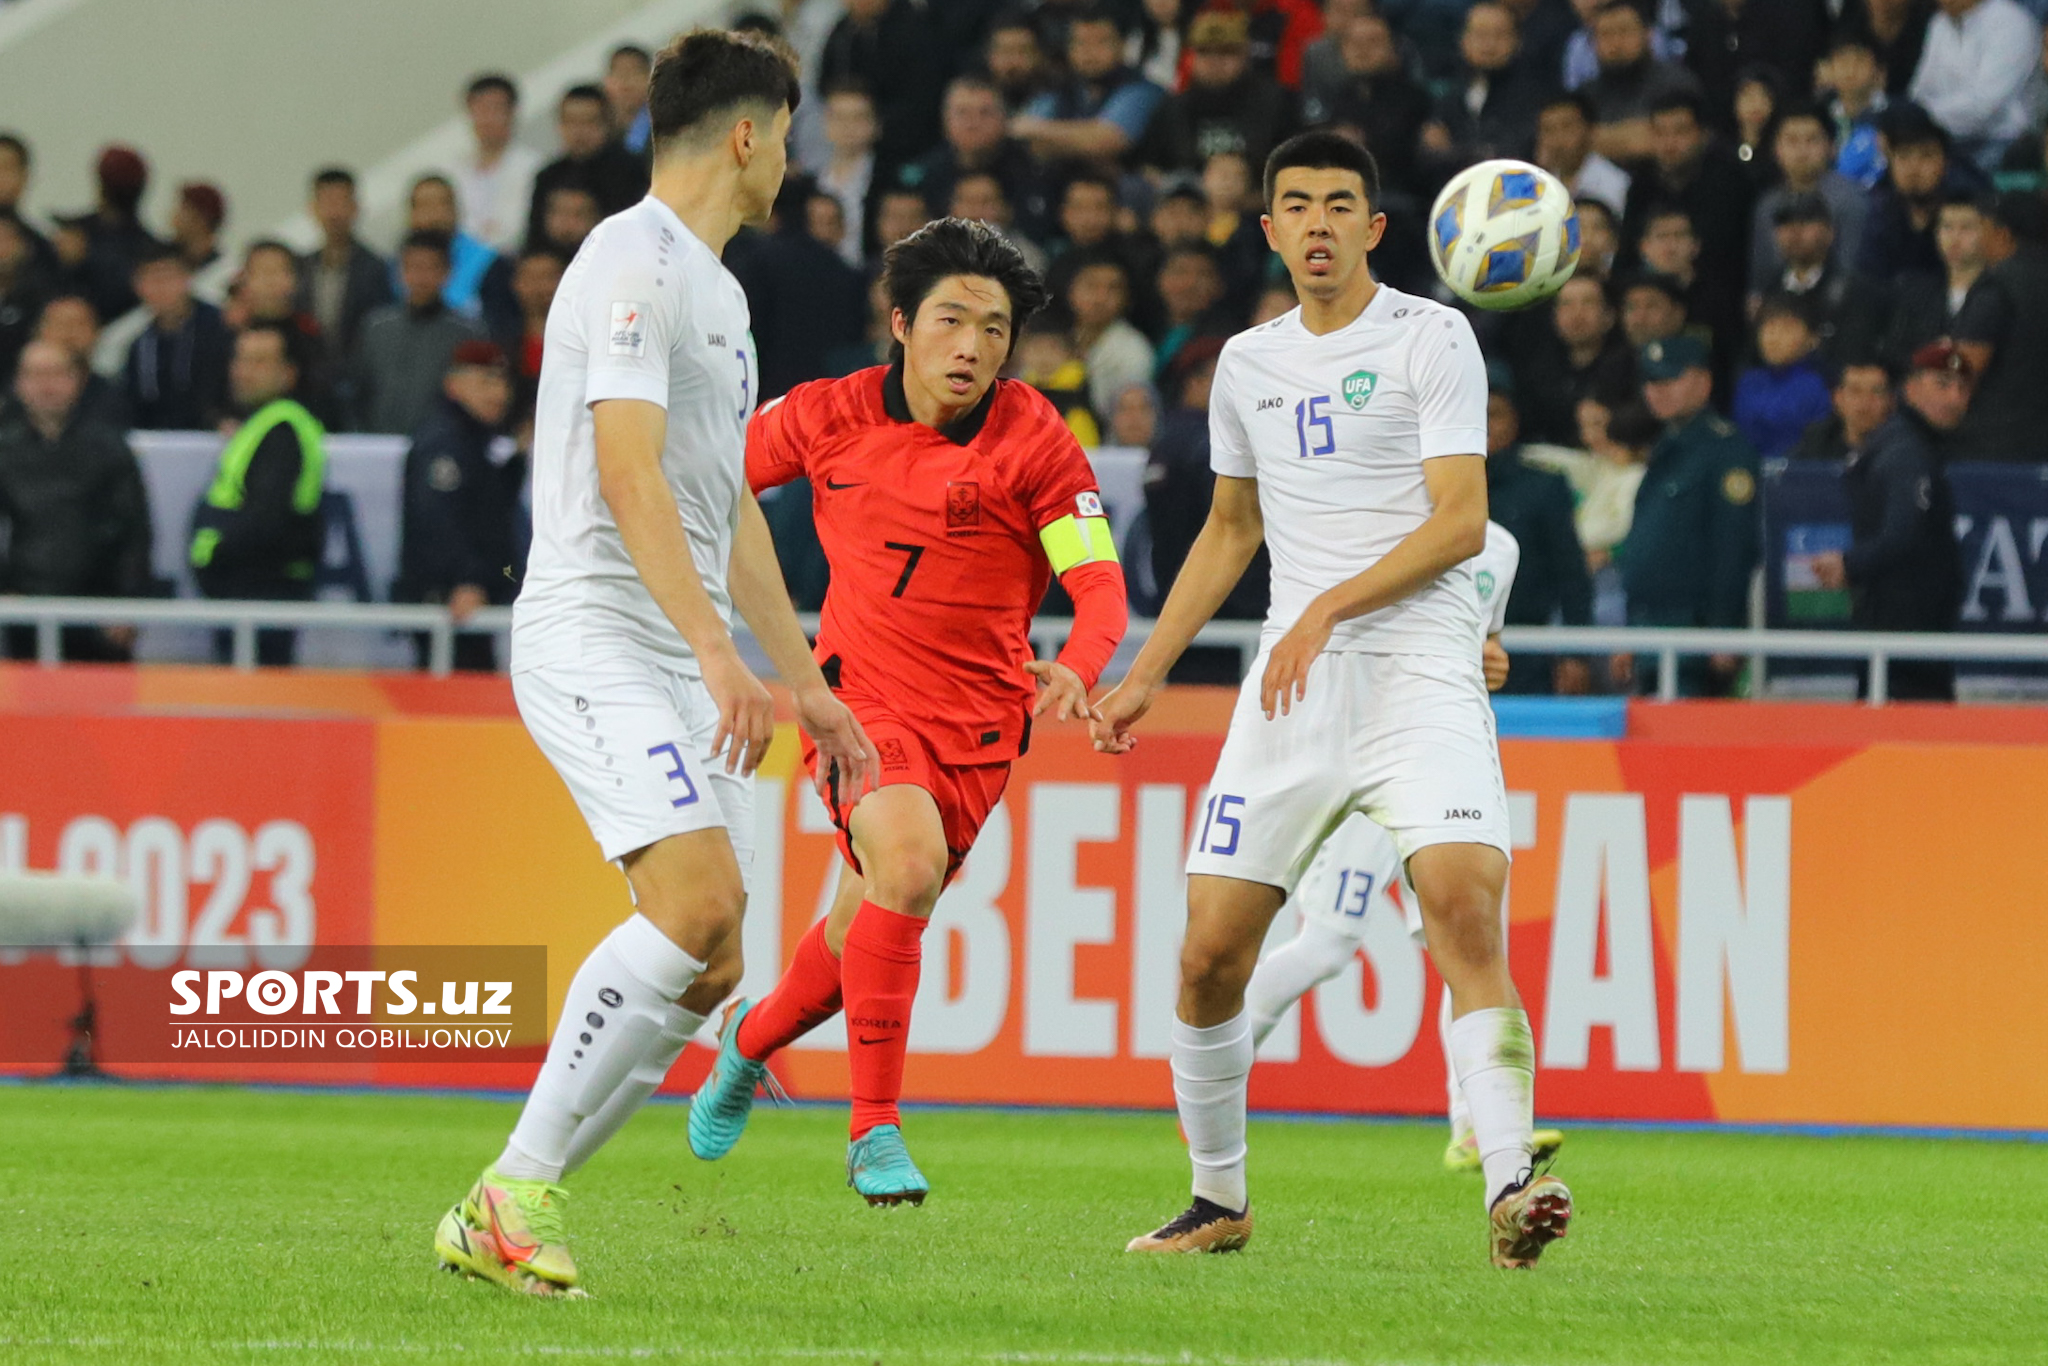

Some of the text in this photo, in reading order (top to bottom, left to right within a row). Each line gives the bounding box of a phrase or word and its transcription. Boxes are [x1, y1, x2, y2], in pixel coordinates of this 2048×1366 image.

[707, 333, 727, 347] JAKO
[736, 349, 749, 420] 3
[1256, 397, 1283, 412] JAKO
[1345, 378, 1371, 394] UFA
[1295, 395, 1336, 458] 15
[884, 541, 926, 598] 7
[647, 741, 699, 809] 3
[1199, 795, 1245, 856] 15
[1444, 808, 1483, 820] JAKO
[1334, 868, 1375, 918] 13
[851, 1018, 902, 1029] KOREA
